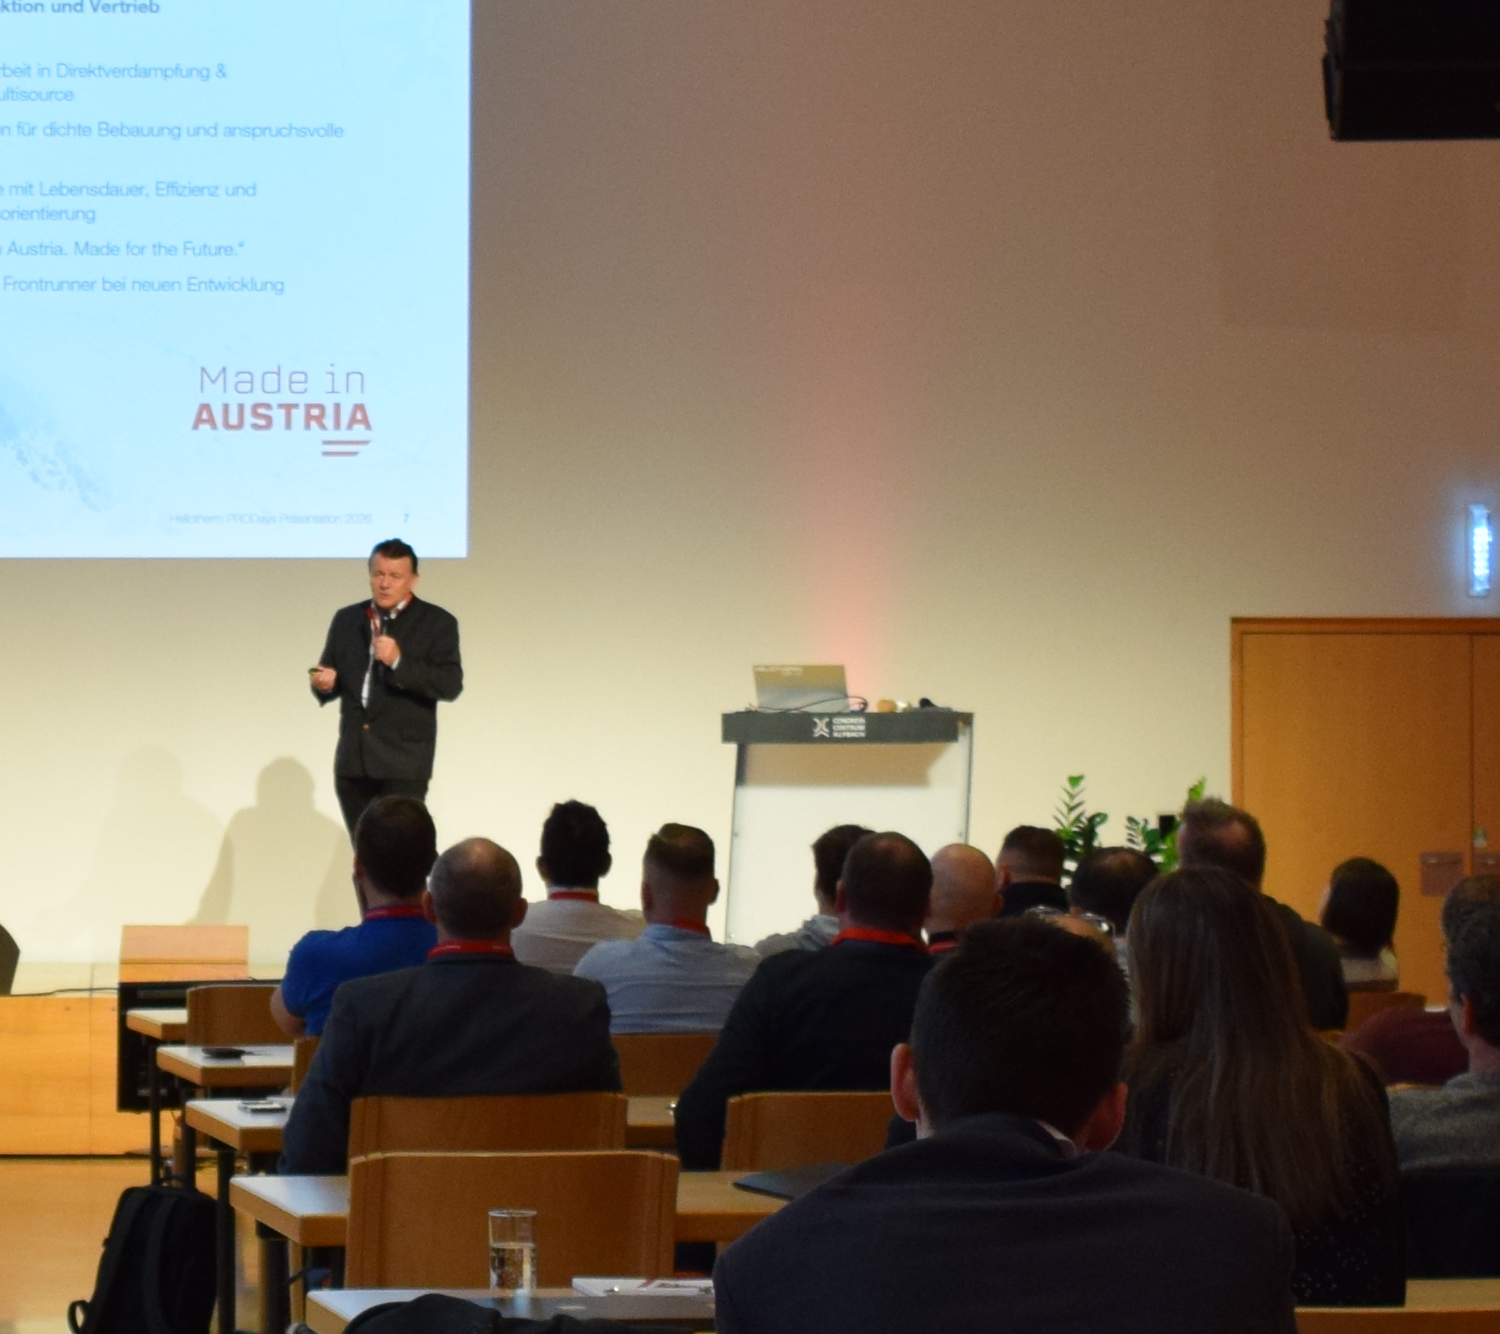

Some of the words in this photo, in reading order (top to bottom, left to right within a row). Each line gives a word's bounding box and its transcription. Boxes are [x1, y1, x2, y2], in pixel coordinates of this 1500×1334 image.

[36, 60, 52, 78] in
[56, 62, 212, 83] Direktverdampfung
[214, 62, 228, 79] &
[15, 120, 38, 137] für
[42, 120, 93, 138] dichte
[97, 120, 183, 142] Bebauung
[185, 121, 219, 138] und
[222, 122, 345, 141] anspruchsvolle
[8, 181, 35, 197] mit
[154, 180, 220, 198] Effizienz
[224, 181, 258, 198] und
[73, 240, 122, 257] Made
[124, 240, 148, 257] for
[151, 241, 179, 257] the
[2, 274, 98, 292] Frontrunner
[101, 276, 127, 293] bei
[131, 279, 183, 293] neuen
[186, 275, 286, 296] Entwicklung
[199, 363, 309, 396] Made
[325, 362, 365, 395] in
[192, 402, 372, 431] AUSTRIA
[403, 513, 410, 523] 7
